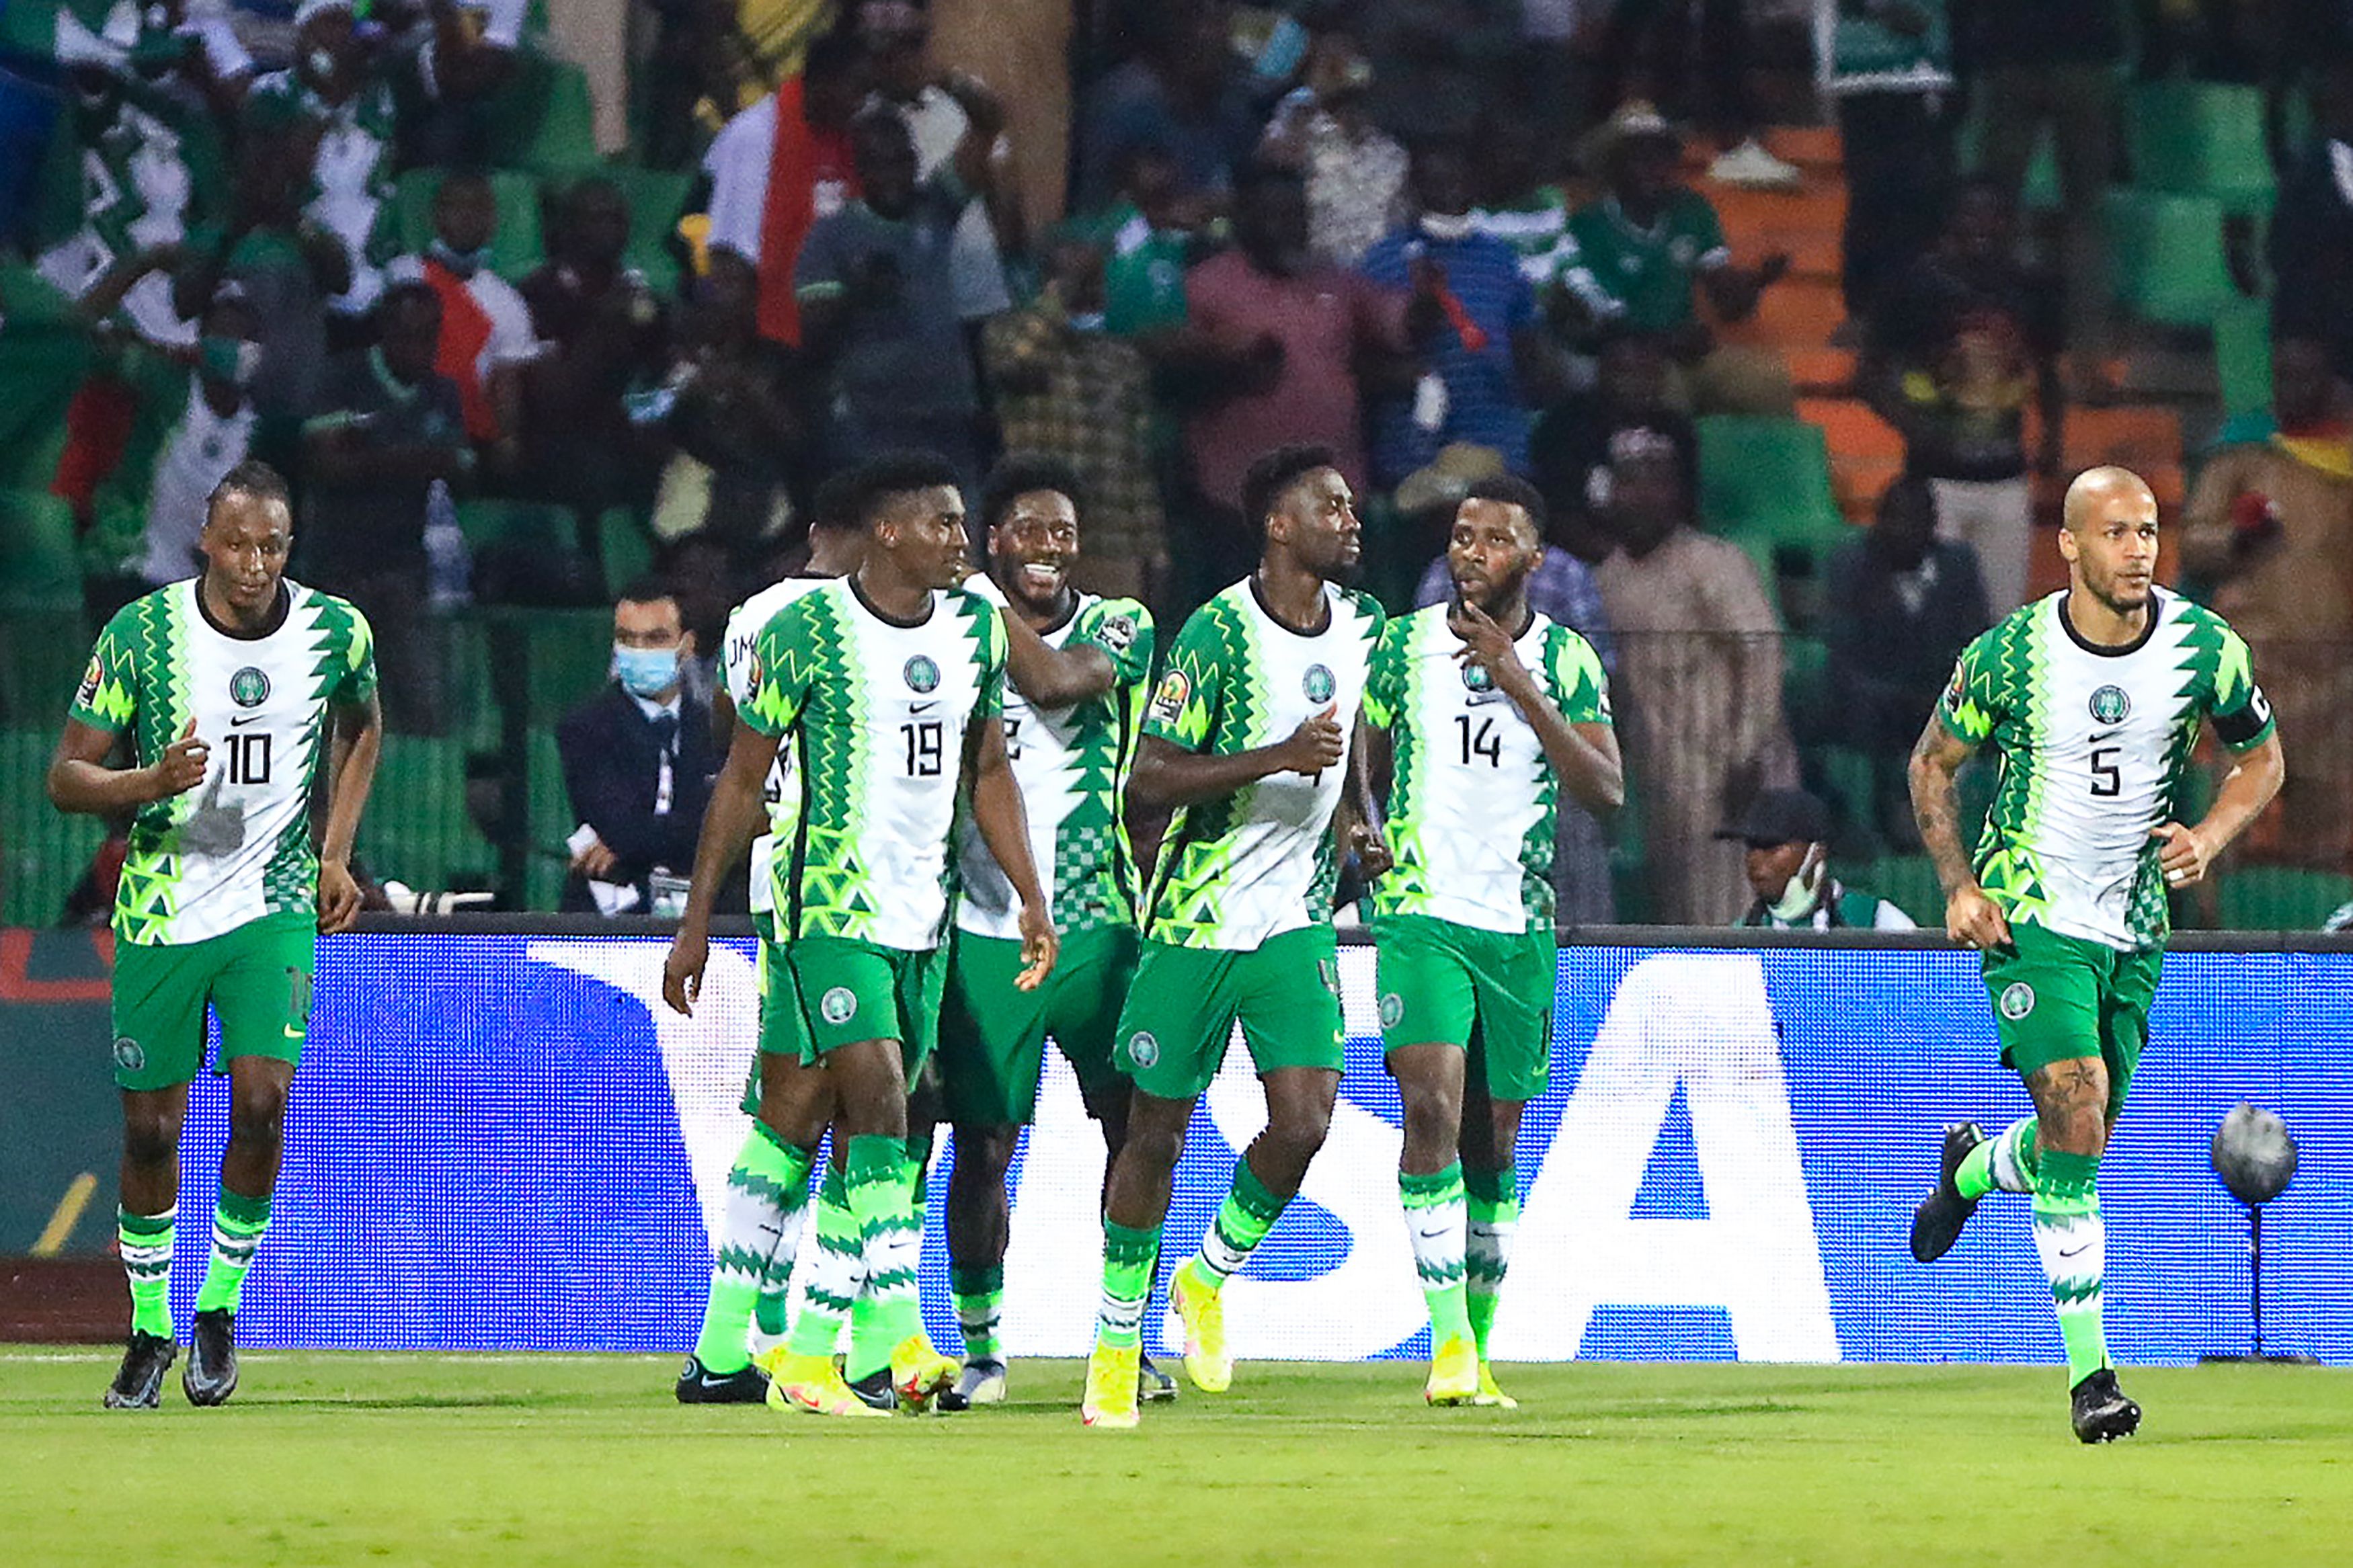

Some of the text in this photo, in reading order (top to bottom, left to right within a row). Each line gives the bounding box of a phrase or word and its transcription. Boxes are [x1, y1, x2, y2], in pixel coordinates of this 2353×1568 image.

[224, 733, 272, 784] 10
[900, 720, 942, 776] 19
[1454, 714, 1501, 768] 14
[2090, 747, 2121, 796] 5
